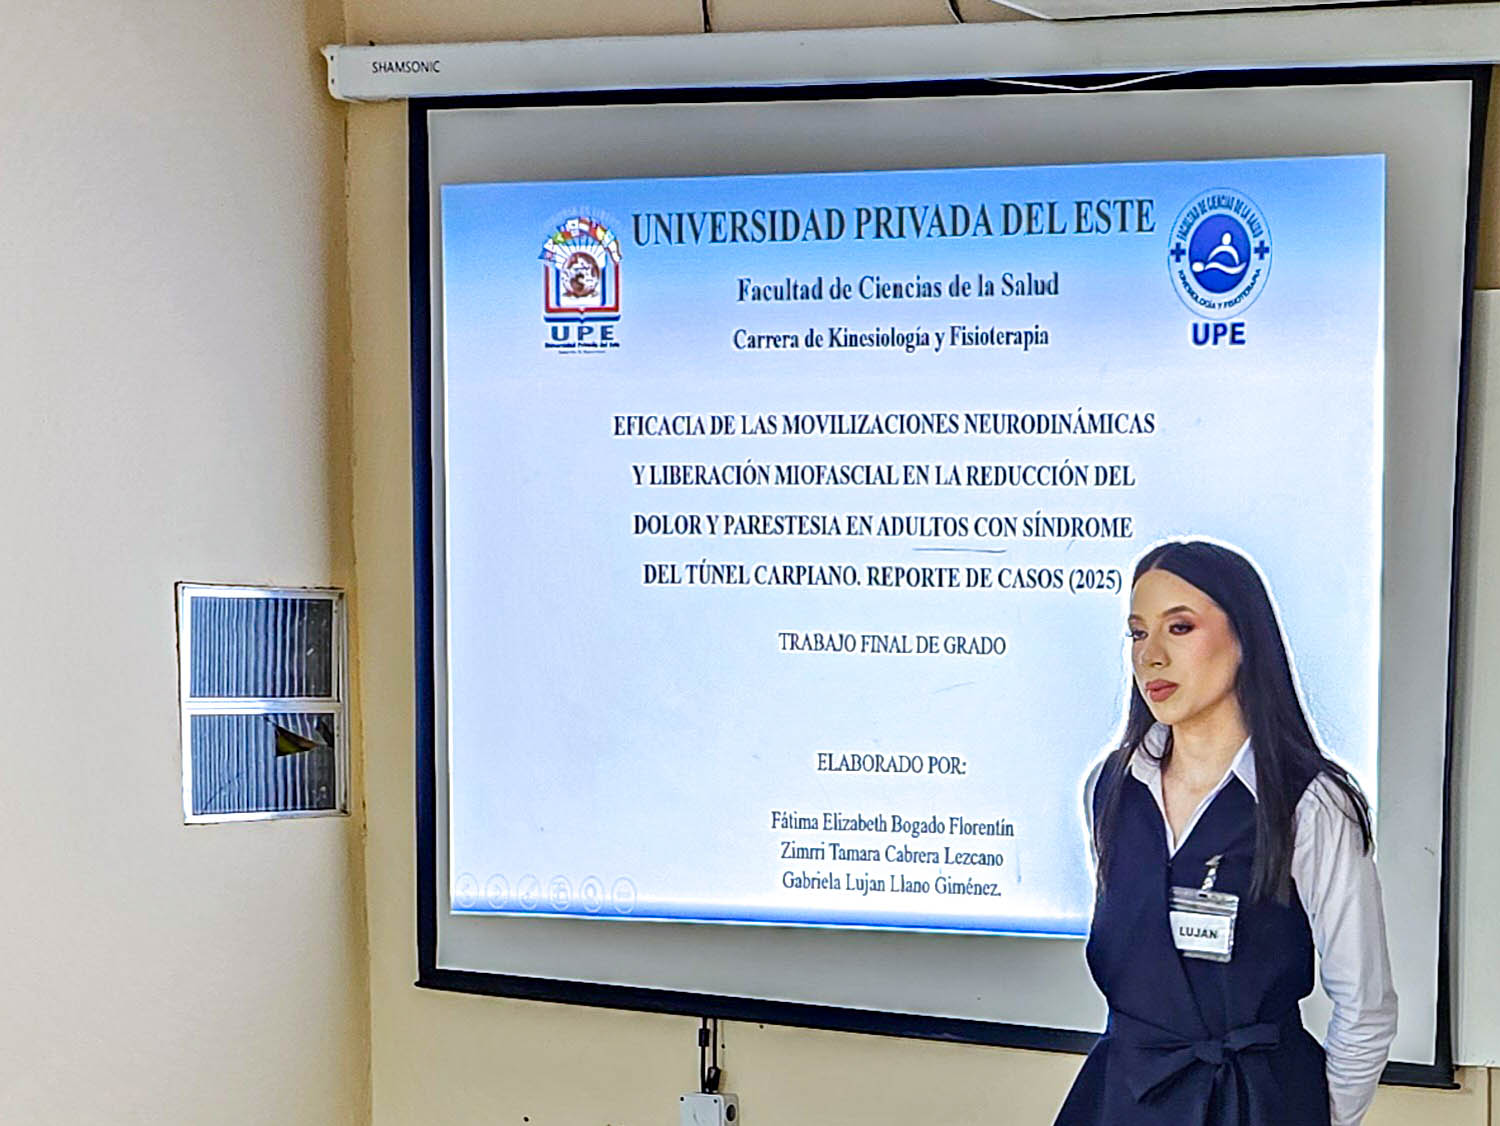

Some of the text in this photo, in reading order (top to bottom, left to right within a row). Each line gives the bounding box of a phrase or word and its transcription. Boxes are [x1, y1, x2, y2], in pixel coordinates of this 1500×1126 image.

[371, 59, 440, 73] SHAMSONIC
[632, 208, 845, 246] UNIVERSIDAD
[855, 203, 993, 240] PRIVADA
[1000, 201, 1068, 236] DEL
[1074, 199, 1156, 234] ESTE
[737, 271, 1060, 301] Facultad de Ciencias de la Salud
[551, 325, 614, 341] UPE
[733, 325, 1049, 353] Carrera de Kinesiología y Fisioterapia
[1192, 322, 1246, 346] UPE
[614, 408, 1155, 436] EFICACIA DE LAS MOVILIZACIONES NEURODINÁMICAS
[632, 459, 1136, 486] Y LIBERACIÓN MIOFASCIAL EN LA REDUCCIÓN DEL
[634, 510, 1133, 538] DOLOR Y PARESTESIA EN ADULTOS CON SÍNDROME
[643, 558, 1122, 594] DEL TÚNEL CARPIANO. REPORTE DE CASOS (2025)
[778, 632, 1006, 655] TRABAJO FINAL DE GRADO
[817, 752, 967, 775] ELABORADO POR:
[771, 811, 1015, 838] Fátima Elizabeth Bogado Florentín
[828, 843, 881, 861] Tamara
[885, 844, 940, 863] Cabrera
[944, 846, 1004, 866] Lezcano
[782, 870, 1002, 897] Gabriela Lujan Llano Giménez.
[1179, 926, 1218, 940] LUJAN
